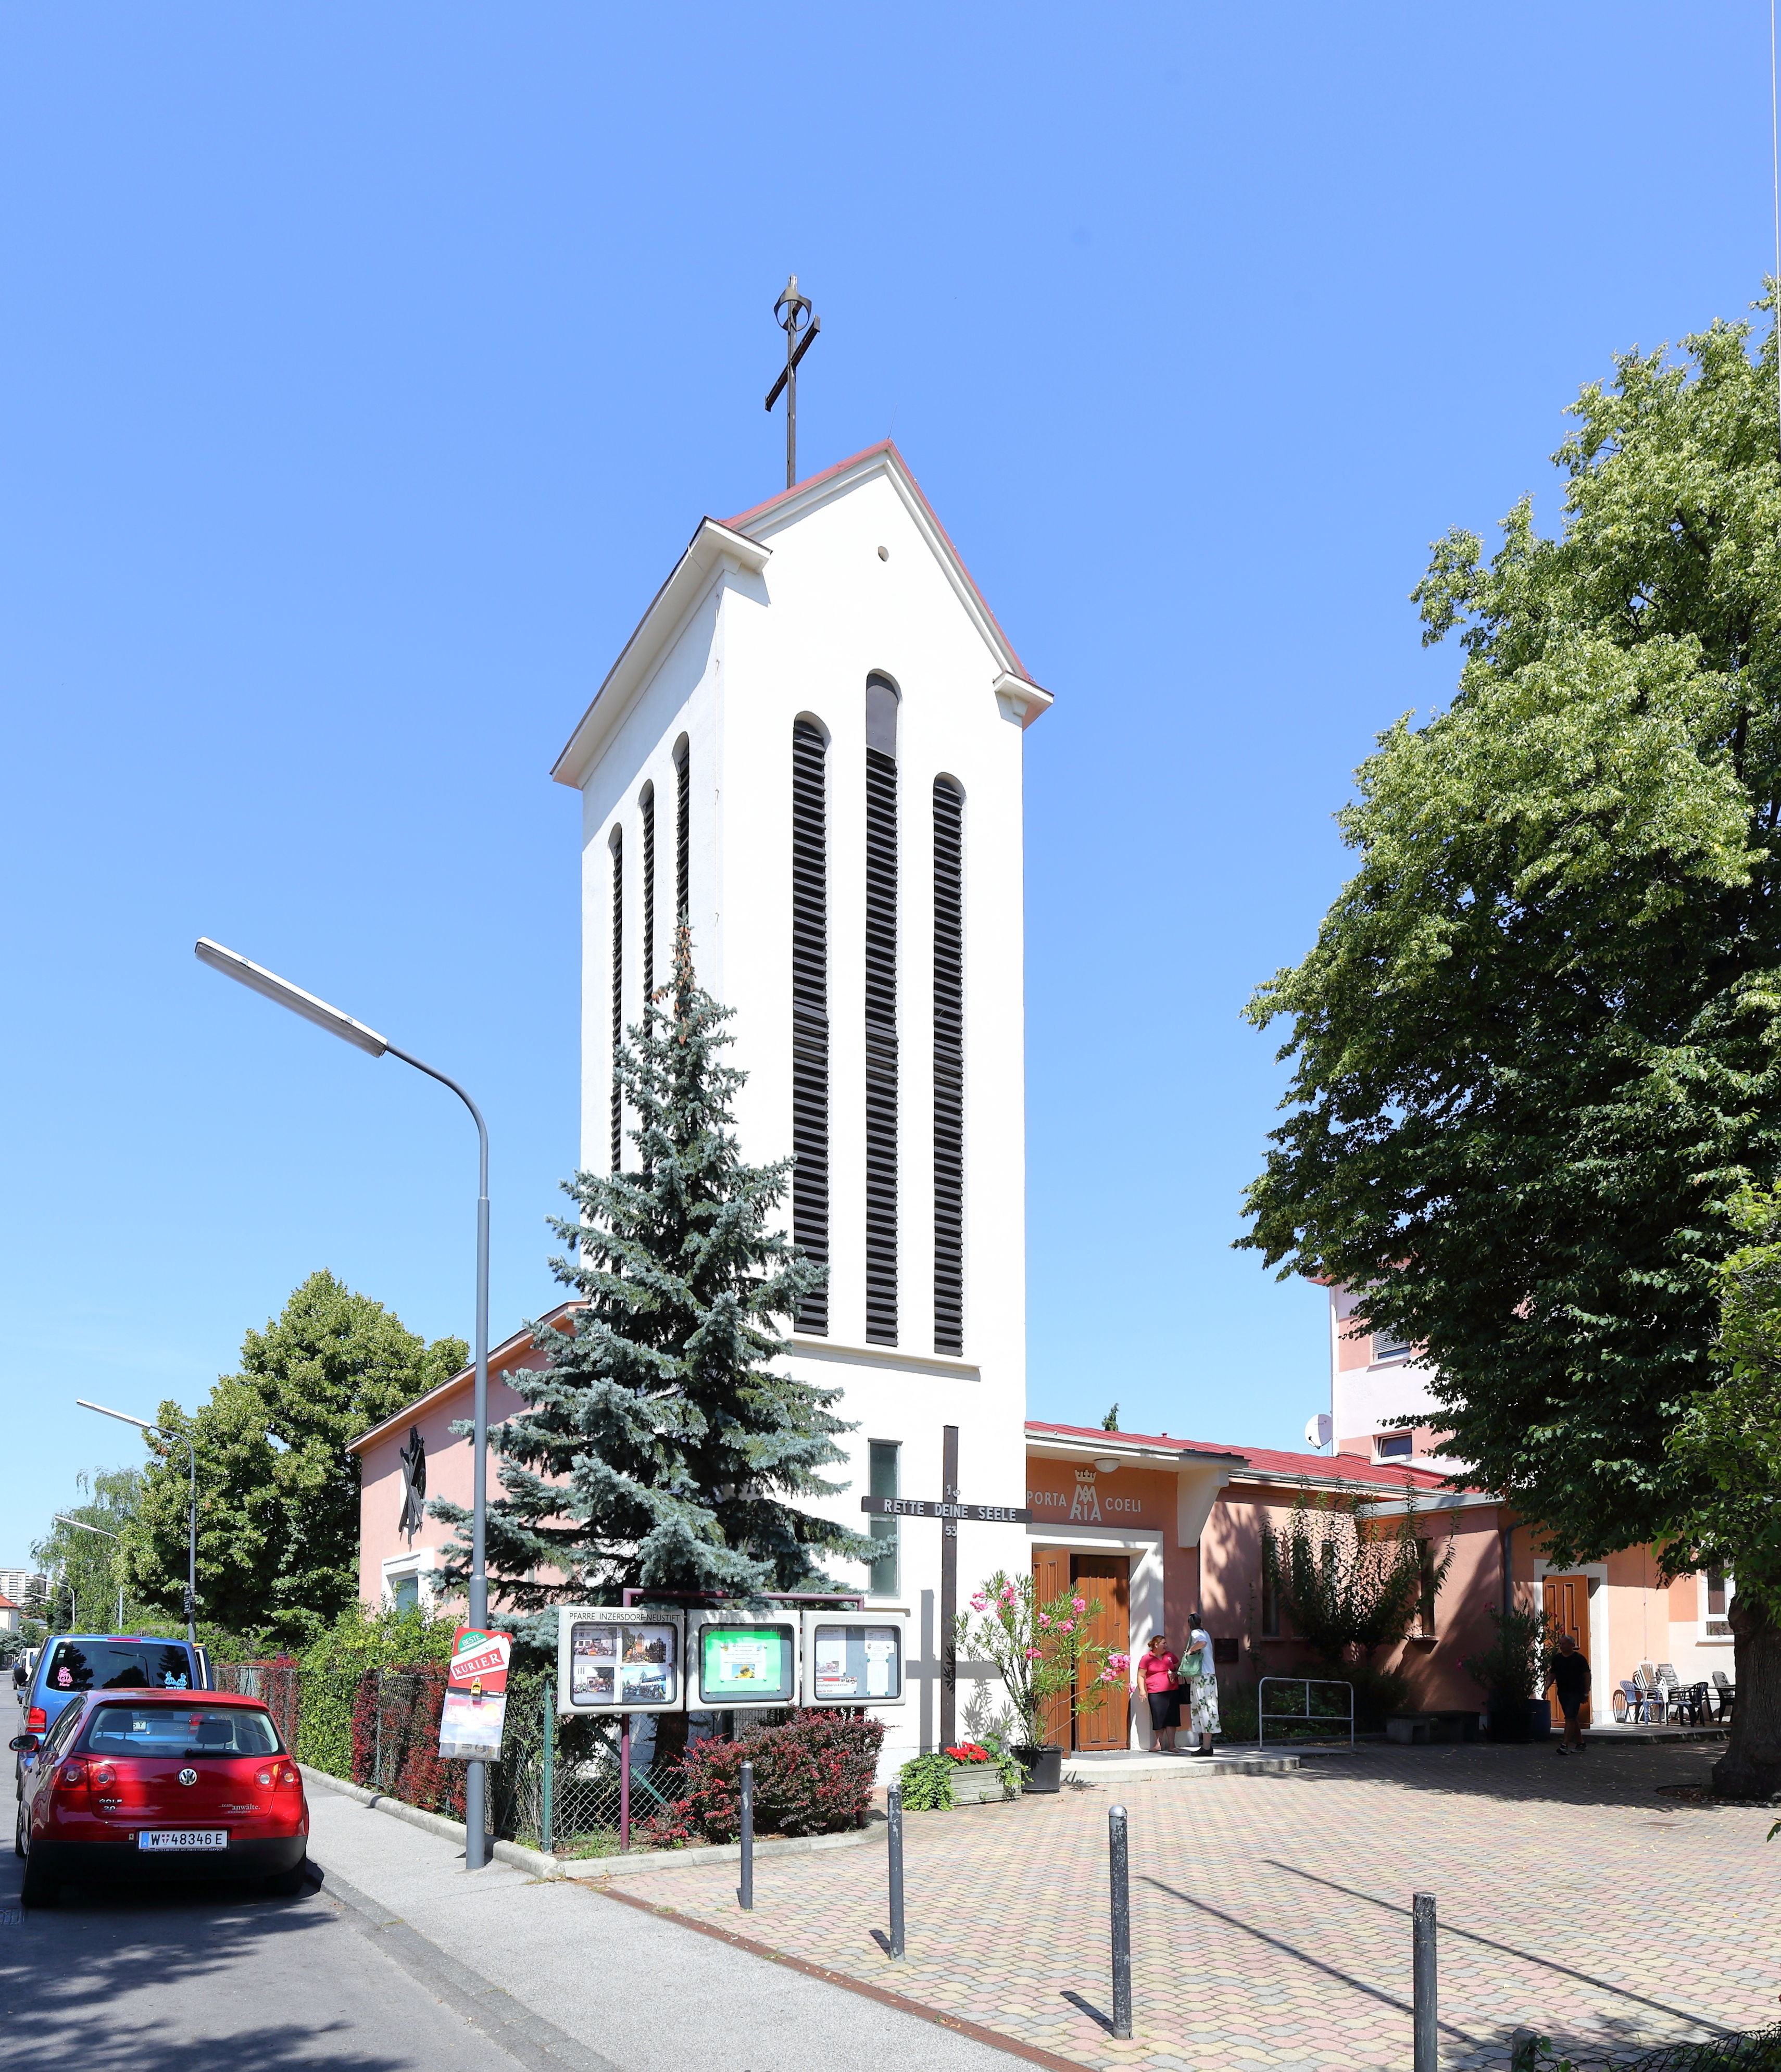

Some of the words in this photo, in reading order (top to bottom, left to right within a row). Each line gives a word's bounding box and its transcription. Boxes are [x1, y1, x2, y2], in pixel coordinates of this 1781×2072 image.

[1026, 1490, 1067, 1507] PORTA
[1105, 1497, 1141, 1512] COELI
[884, 1499, 924, 1515] RETTE
[934, 1503, 969, 1518] DEINE
[979, 1506, 1016, 1522] SEELE
[945, 1525, 957, 1537] 53
[599, 1613, 680, 1622] INZERSDORF-NEUSTIFT
[461, 1634, 481, 1646] BESTE
[455, 1653, 501, 1675] KURIER
